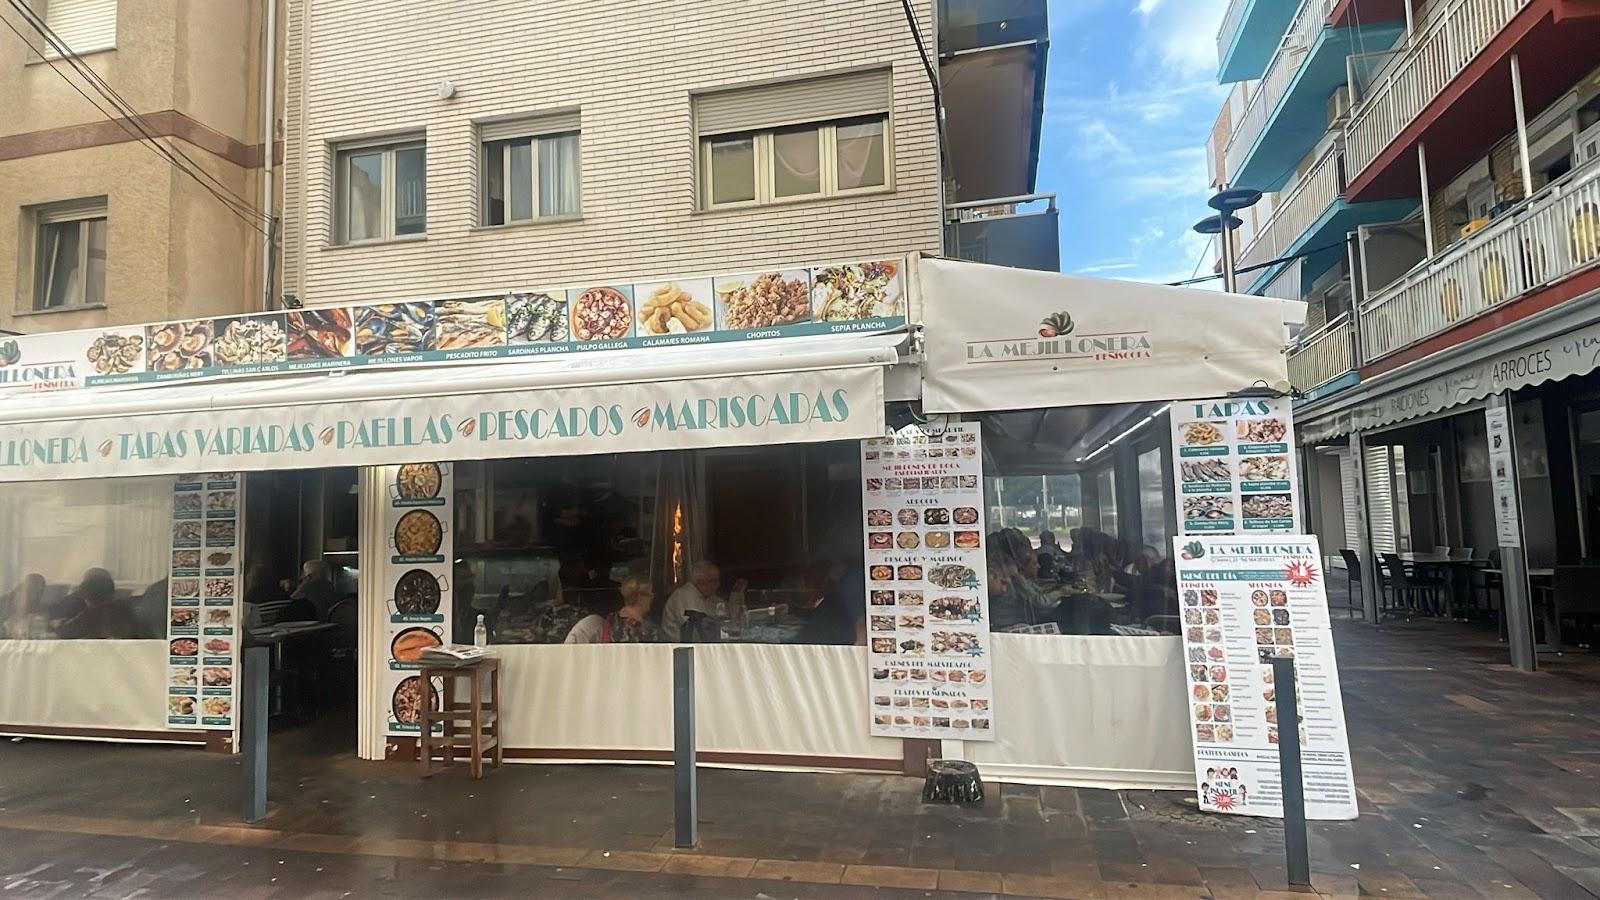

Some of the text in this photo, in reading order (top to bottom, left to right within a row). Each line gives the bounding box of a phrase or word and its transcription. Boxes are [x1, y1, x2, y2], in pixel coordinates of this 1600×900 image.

[831, 320, 886, 332] SEPIA PLANCHA
[746, 329, 780, 339] CHOPITOS
[680, 335, 710, 344] ROMANA
[508, 345, 569, 355] SARDINAS PLANCHA
[576, 341, 627, 351] PULPO GALLEGA
[967, 335, 1151, 358] LA MEJILLONERA
[446, 350, 498, 360] PESCADITO FRITO
[1492, 349, 1553, 383] ARROCES
[1192, 400, 1270, 418] TAPAS
[118, 429, 188, 460] TAPAS
[195, 420, 315, 457] VARIADAS
[337, 413, 453, 450] PAELLAS
[480, 404, 624, 442] PESCADOS
[651, 388, 850, 433] MARISCADAS
[1210, 545, 1313, 555] LA MEJILLONERA
